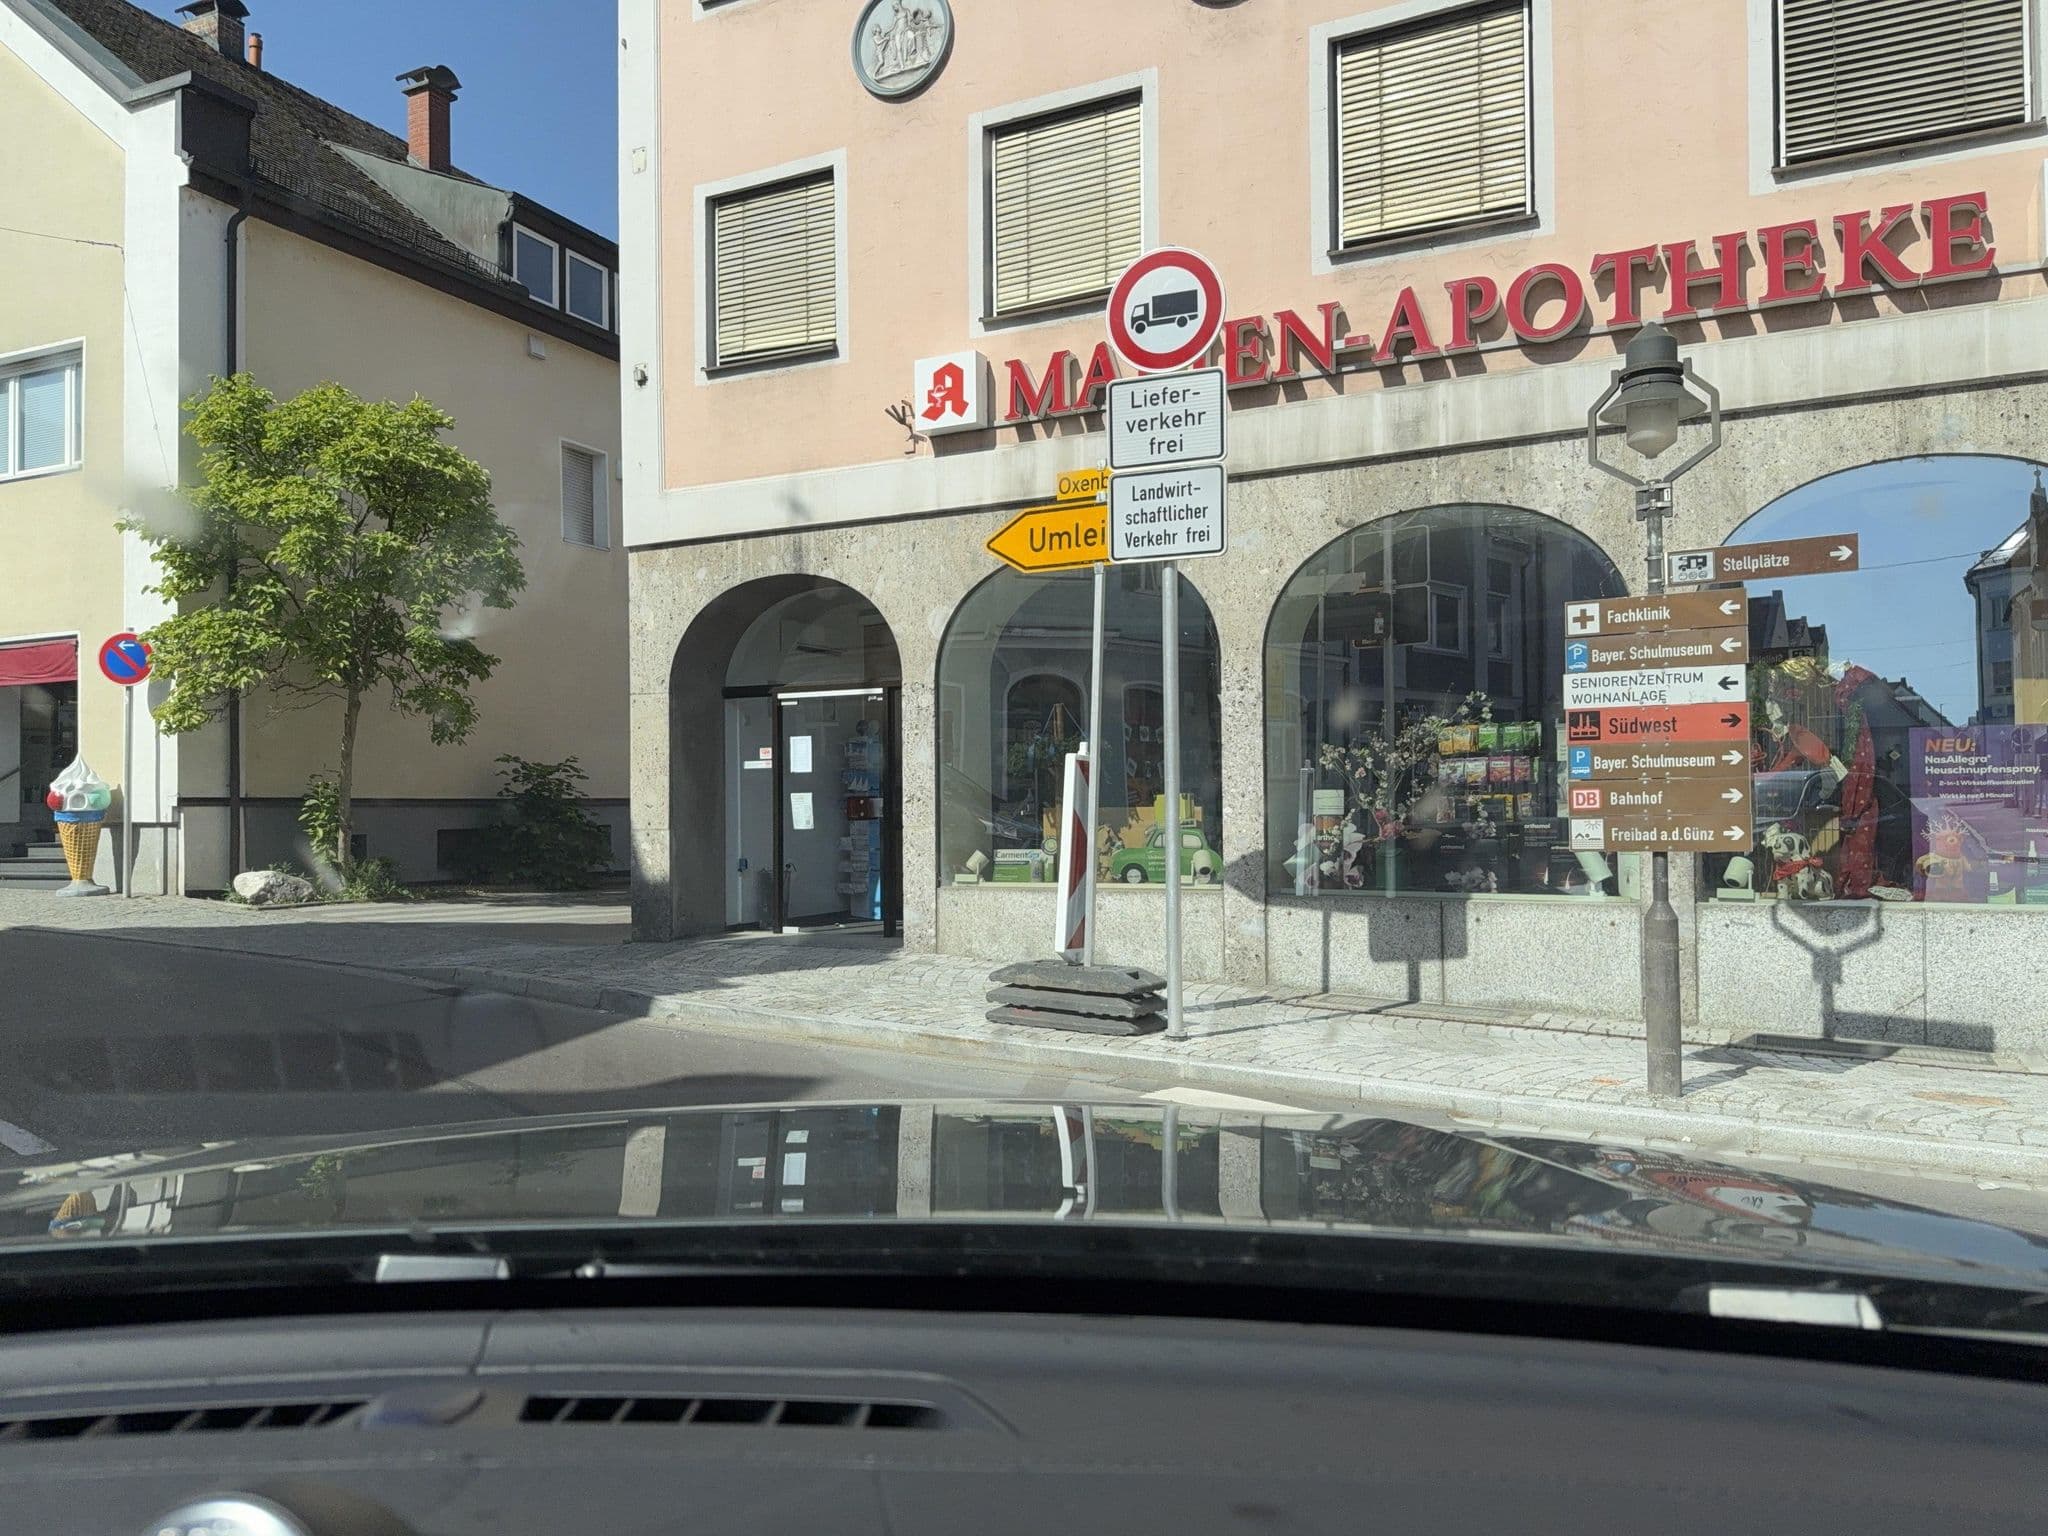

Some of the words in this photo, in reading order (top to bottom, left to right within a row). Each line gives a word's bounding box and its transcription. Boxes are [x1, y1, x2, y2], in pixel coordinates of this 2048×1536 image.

[1004, 190, 1996, 421] MAEN-APOTHEKE
[1130, 386, 1201, 409] Liefer-
[1126, 408, 1206, 434] verkehr
[1149, 434, 1184, 455] frei
[1058, 471, 1108, 495] Oxenb
[1131, 481, 1201, 503] Landwirt-
[1125, 504, 1209, 526] schaftlicher
[1029, 519, 1106, 553] Umlei
[1125, 528, 1178, 549] Verkehr
[1186, 524, 1210, 544] frei
[1722, 553, 1790, 572] Stellplätze
[1607, 606, 1671, 624] Fachklinik
[1592, 648, 1626, 663] Bayer.
[1630, 642, 1713, 660] Schulmuseum
[1571, 672, 1704, 689] SENIORENZENTRUM
[1571, 690, 1667, 705] WOHNANLAGE
[1609, 716, 1678, 734] Südwest
[1594, 754, 1629, 771] Bayer.
[1632, 752, 1716, 768] Schulmuseum
[1575, 792, 1598, 807] DB
[1610, 790, 1664, 806] Bahnhof
[1611, 826, 1658, 842] Freibad
